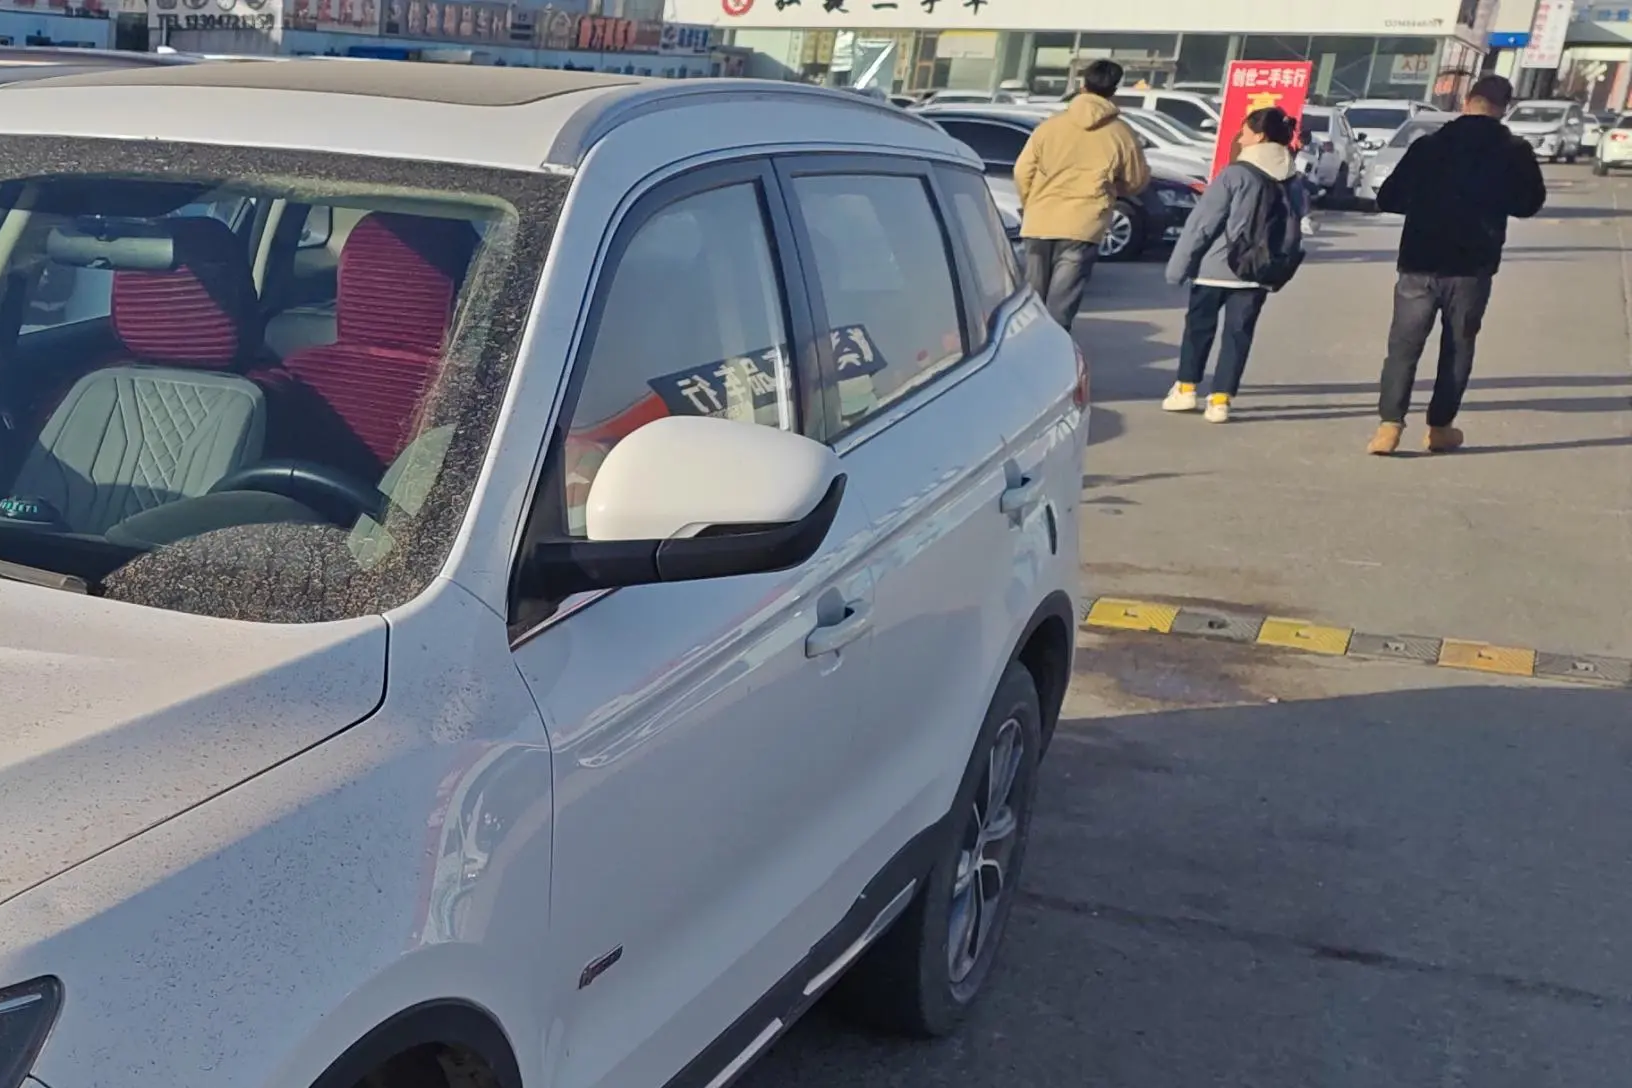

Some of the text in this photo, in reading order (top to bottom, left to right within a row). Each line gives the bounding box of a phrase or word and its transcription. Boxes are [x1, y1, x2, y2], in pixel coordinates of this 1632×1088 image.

[1232, 67, 1308, 88] 创世二手车行
